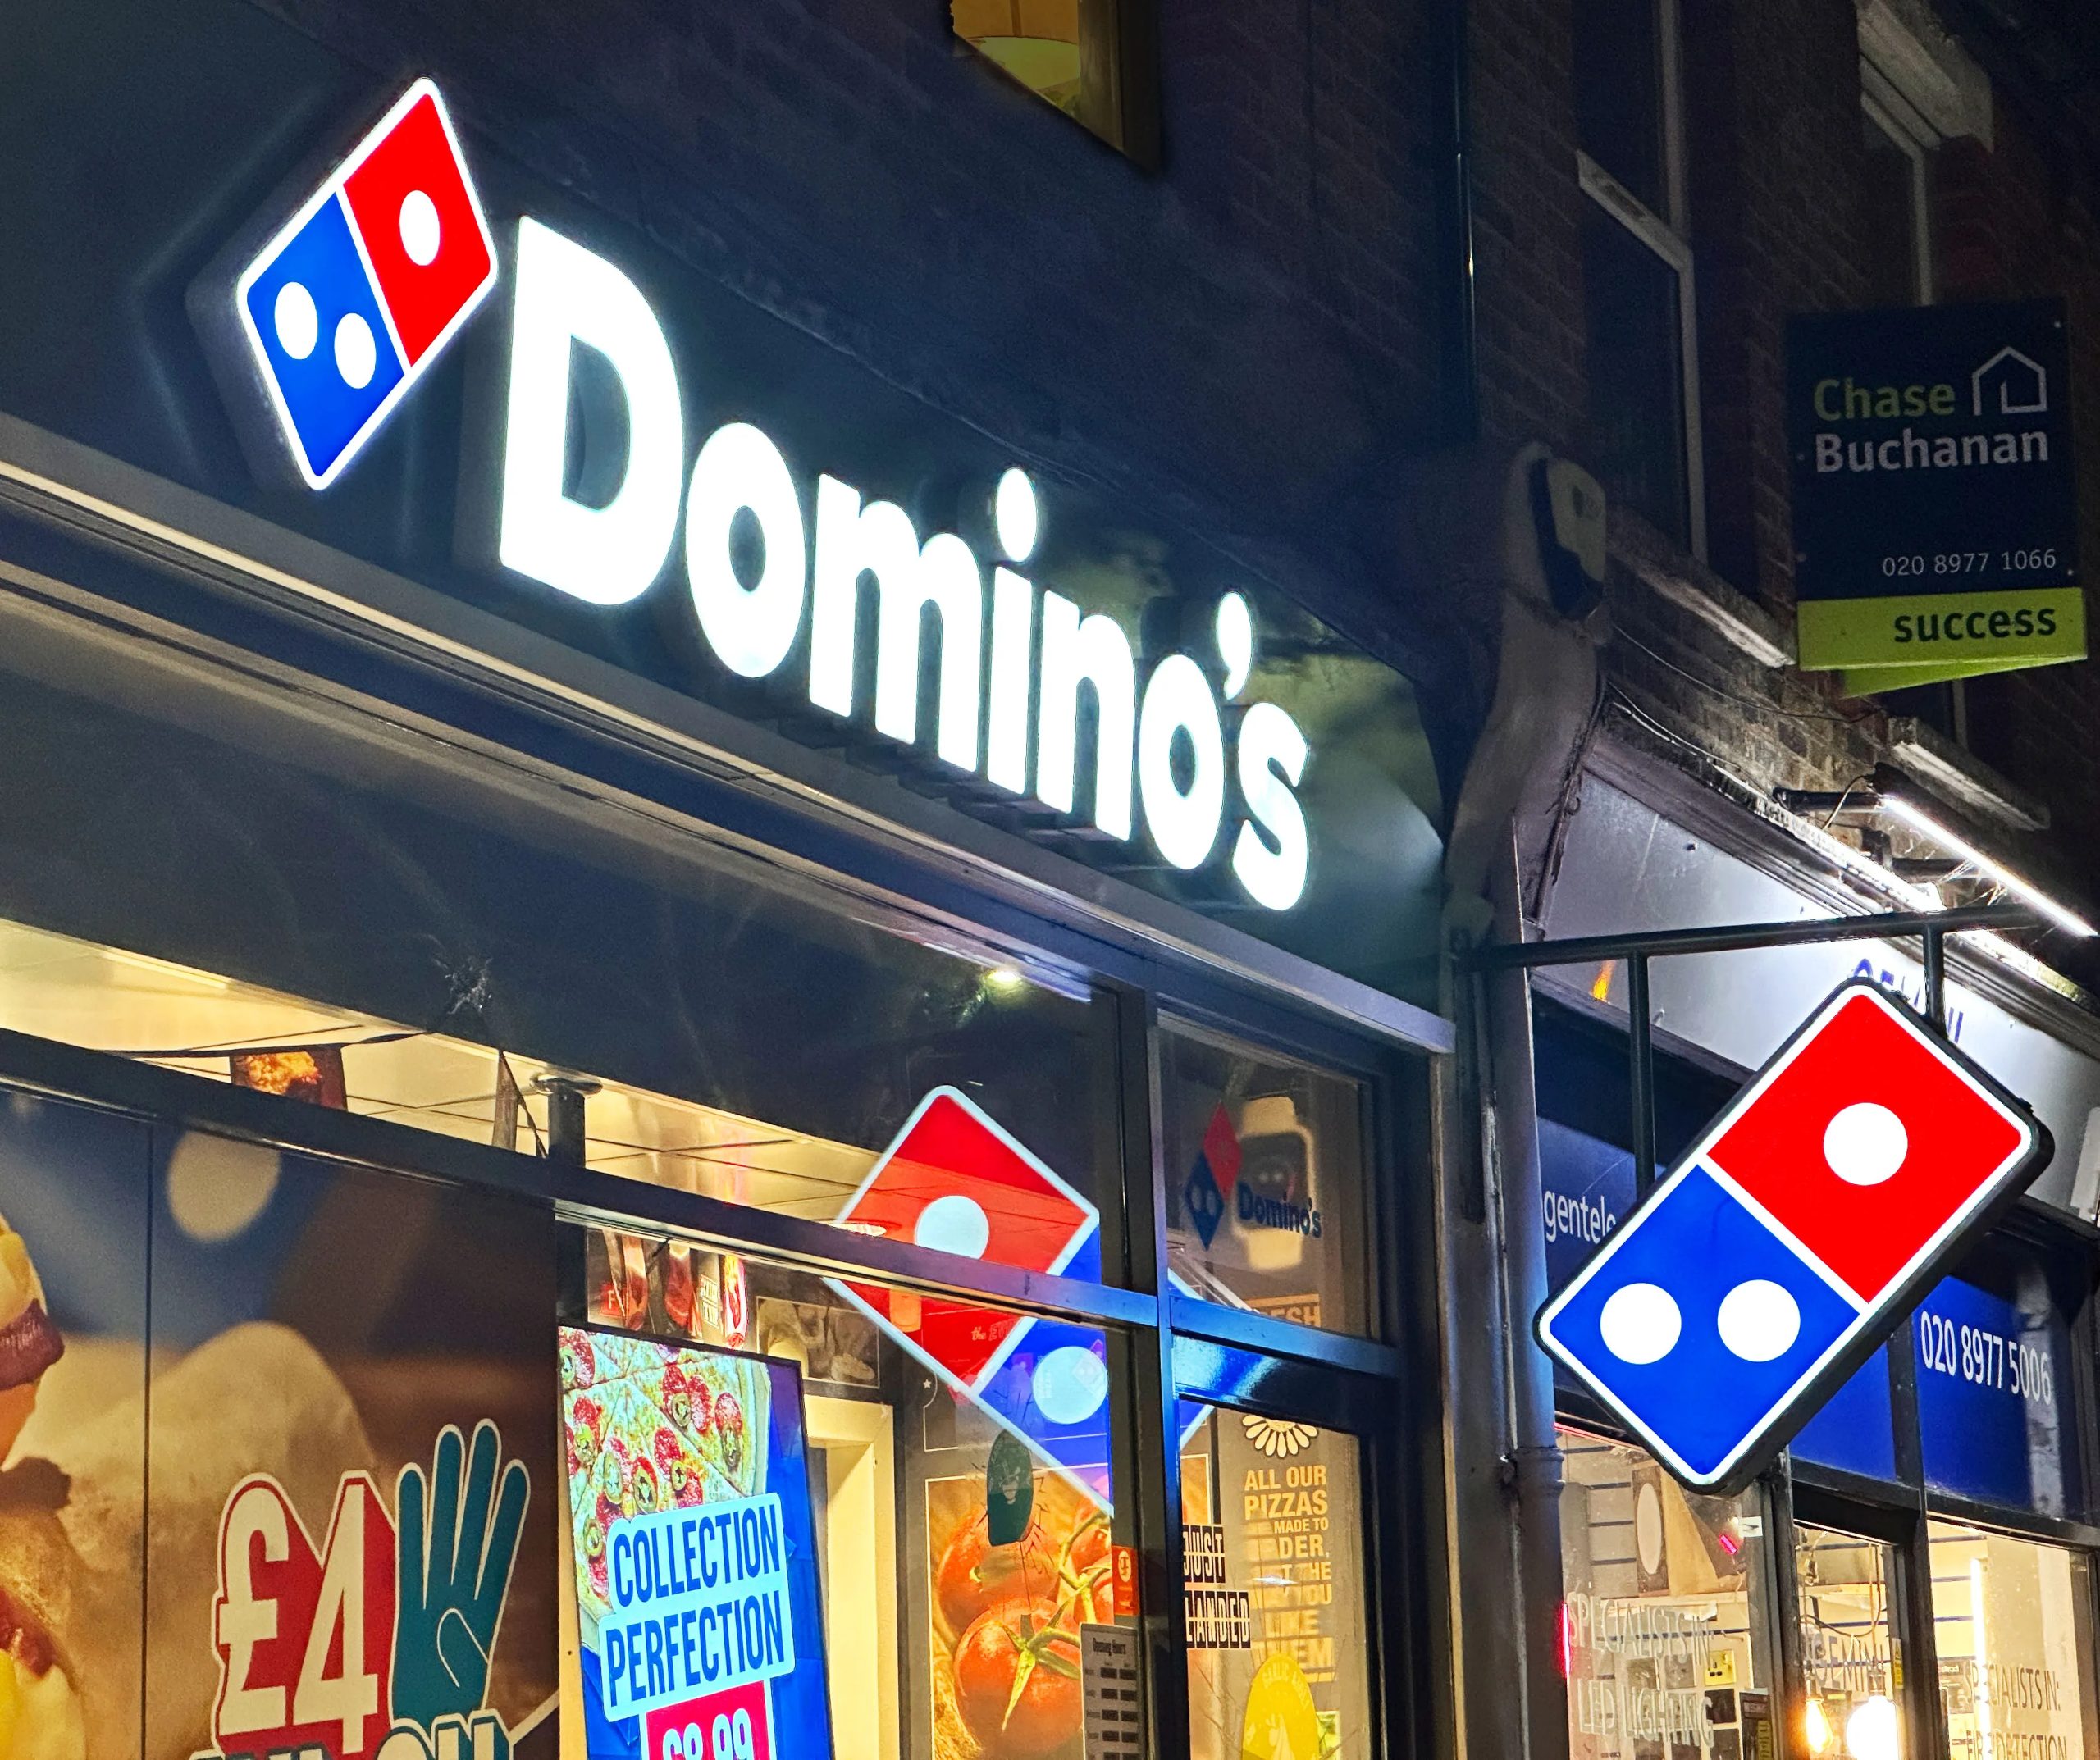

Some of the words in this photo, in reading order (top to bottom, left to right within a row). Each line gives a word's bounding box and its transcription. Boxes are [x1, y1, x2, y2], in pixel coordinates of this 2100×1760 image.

[1813, 377, 1956, 422] Chase
[1815, 427, 2048, 473] Buchanan
[500, 215, 1310, 911] Domino's
[1882, 557, 1925, 577] 020
[1933, 552, 1990, 575] 8977
[2001, 549, 2057, 571] 1066
[1894, 607, 2057, 644] success
[1238, 1180, 1322, 1238] Domino's
[1920, 1311, 1956, 1376] 020
[1961, 1325, 2002, 1388] 8977
[2009, 1341, 2051, 1404] 5006
[1244, 1469, 1281, 1491] ALL
[1285, 1465, 1327, 1488] OUR
[1244, 1489, 1329, 1521] PIZZAS
[1274, 1519, 1312, 1534] MADE
[1312, 1516, 1329, 1531] TO
[614, 1507, 780, 1608] COLLECTION
[1183, 1531, 1223, 1577] JUST
[218, 1481, 379, 1754] £4
[1185, 1596, 1250, 1643] LANDED
[605, 1591, 785, 1708] PERFECTION
[1577, 1677, 1617, 1736] LED
[1963, 1660, 2043, 1710] SPCIALISTS
